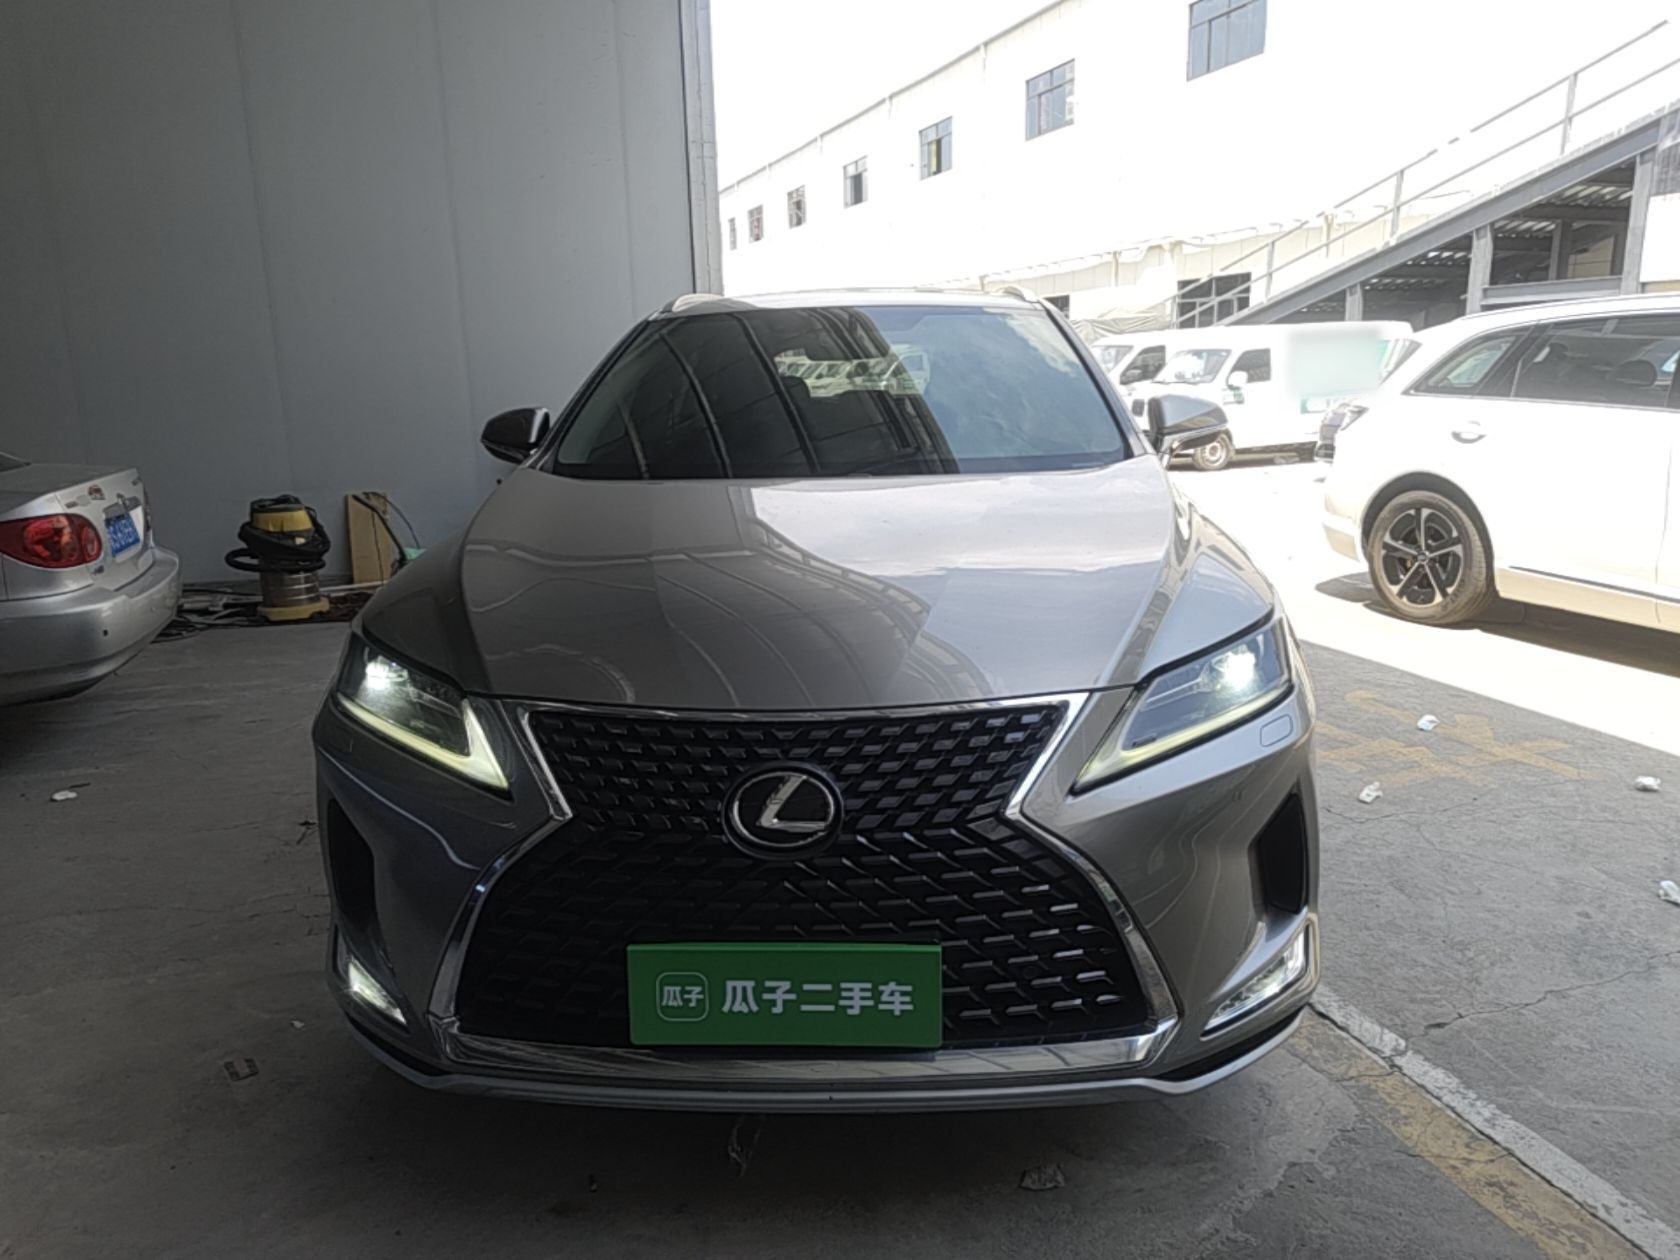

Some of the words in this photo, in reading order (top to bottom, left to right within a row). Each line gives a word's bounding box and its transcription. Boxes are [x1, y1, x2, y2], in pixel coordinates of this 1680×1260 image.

[661, 986, 704, 1007] 瓜子
[721, 980, 914, 1016] 瓜子二手车
